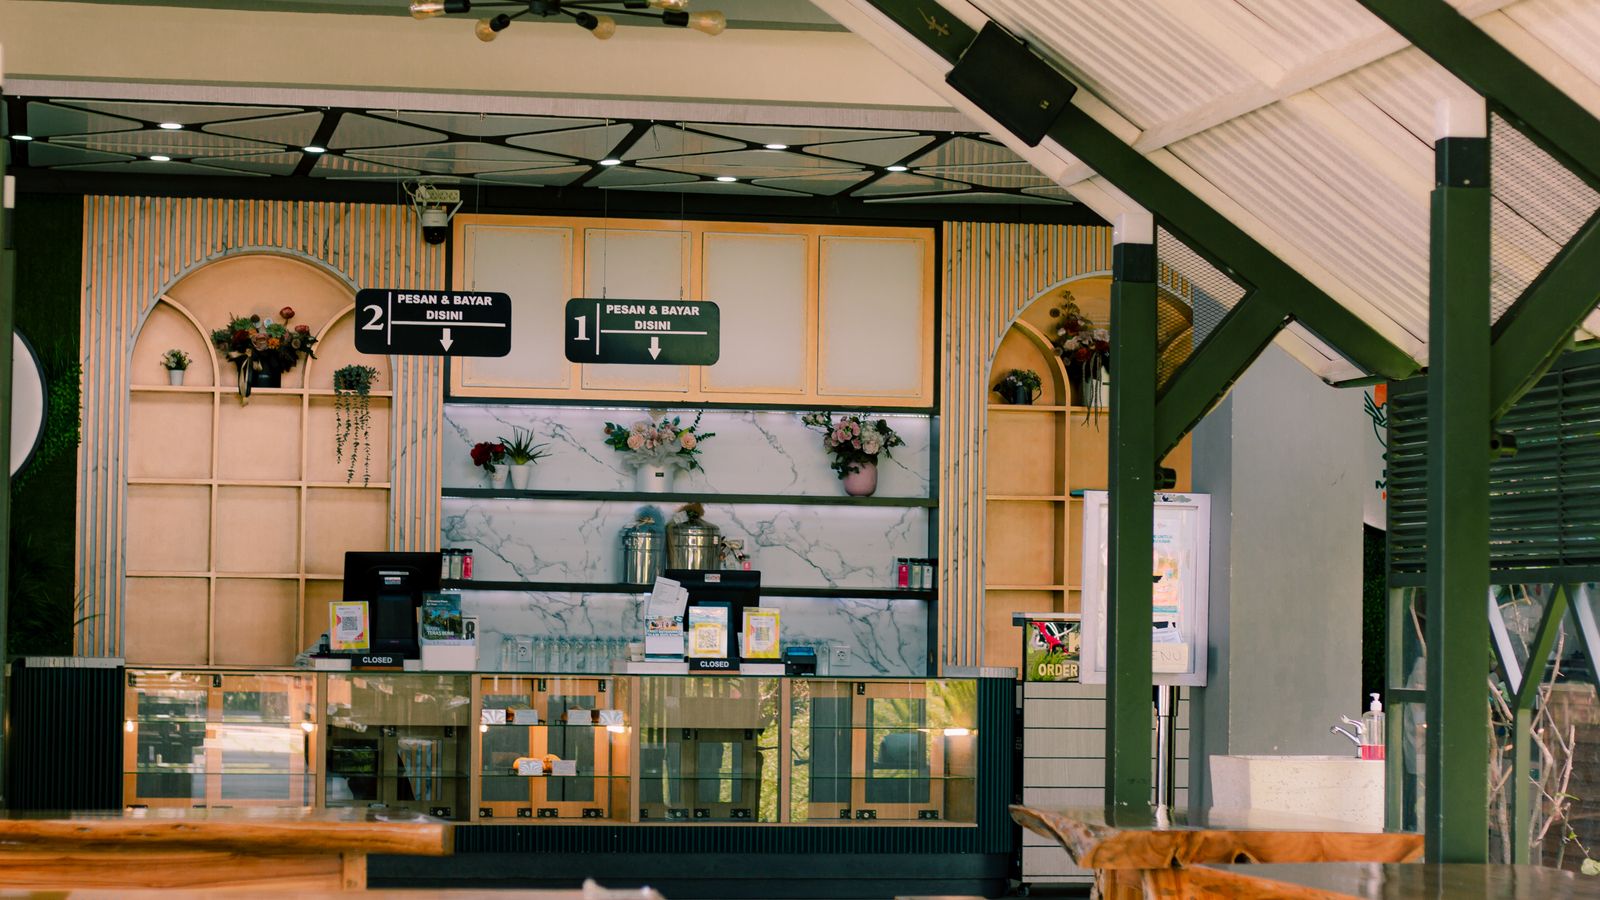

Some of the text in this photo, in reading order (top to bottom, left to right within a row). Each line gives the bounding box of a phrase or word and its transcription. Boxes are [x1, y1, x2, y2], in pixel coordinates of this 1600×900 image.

[397, 293, 493, 306] PESAN & BAYAR
[425, 310, 463, 321] DISINI
[606, 304, 700, 316] PESAN & BAYAR
[361, 304, 384, 331] 2
[573, 315, 590, 341] 1
[634, 320, 671, 331] DISINI
[362, 656, 393, 664] CLOSED
[699, 660, 730, 668] CLOSED
[1038, 663, 1079, 677] ORDER
